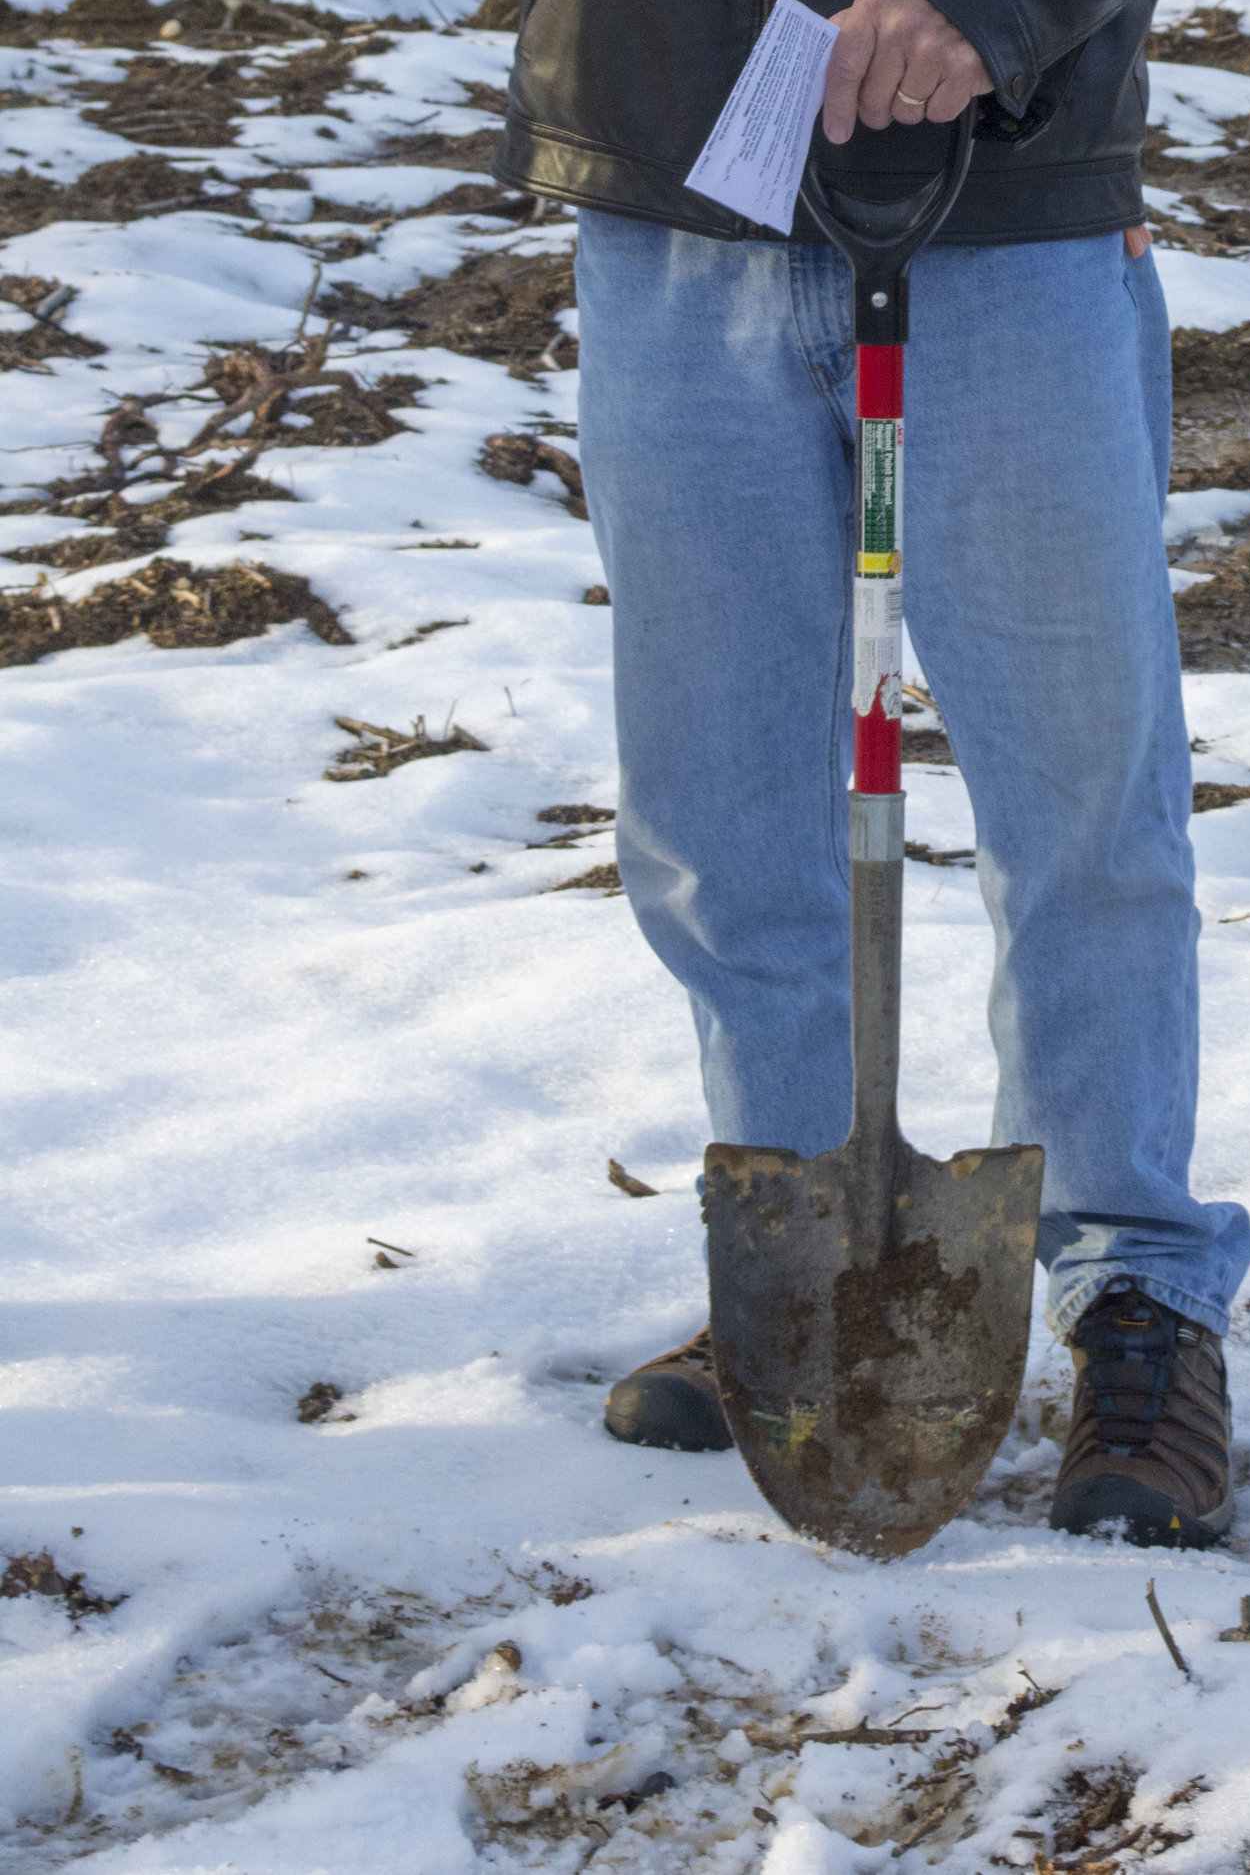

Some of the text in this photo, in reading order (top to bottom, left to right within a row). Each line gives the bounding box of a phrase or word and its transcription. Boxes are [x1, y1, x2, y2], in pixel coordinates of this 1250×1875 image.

[884, 423, 893, 505] Round Point Shovel
